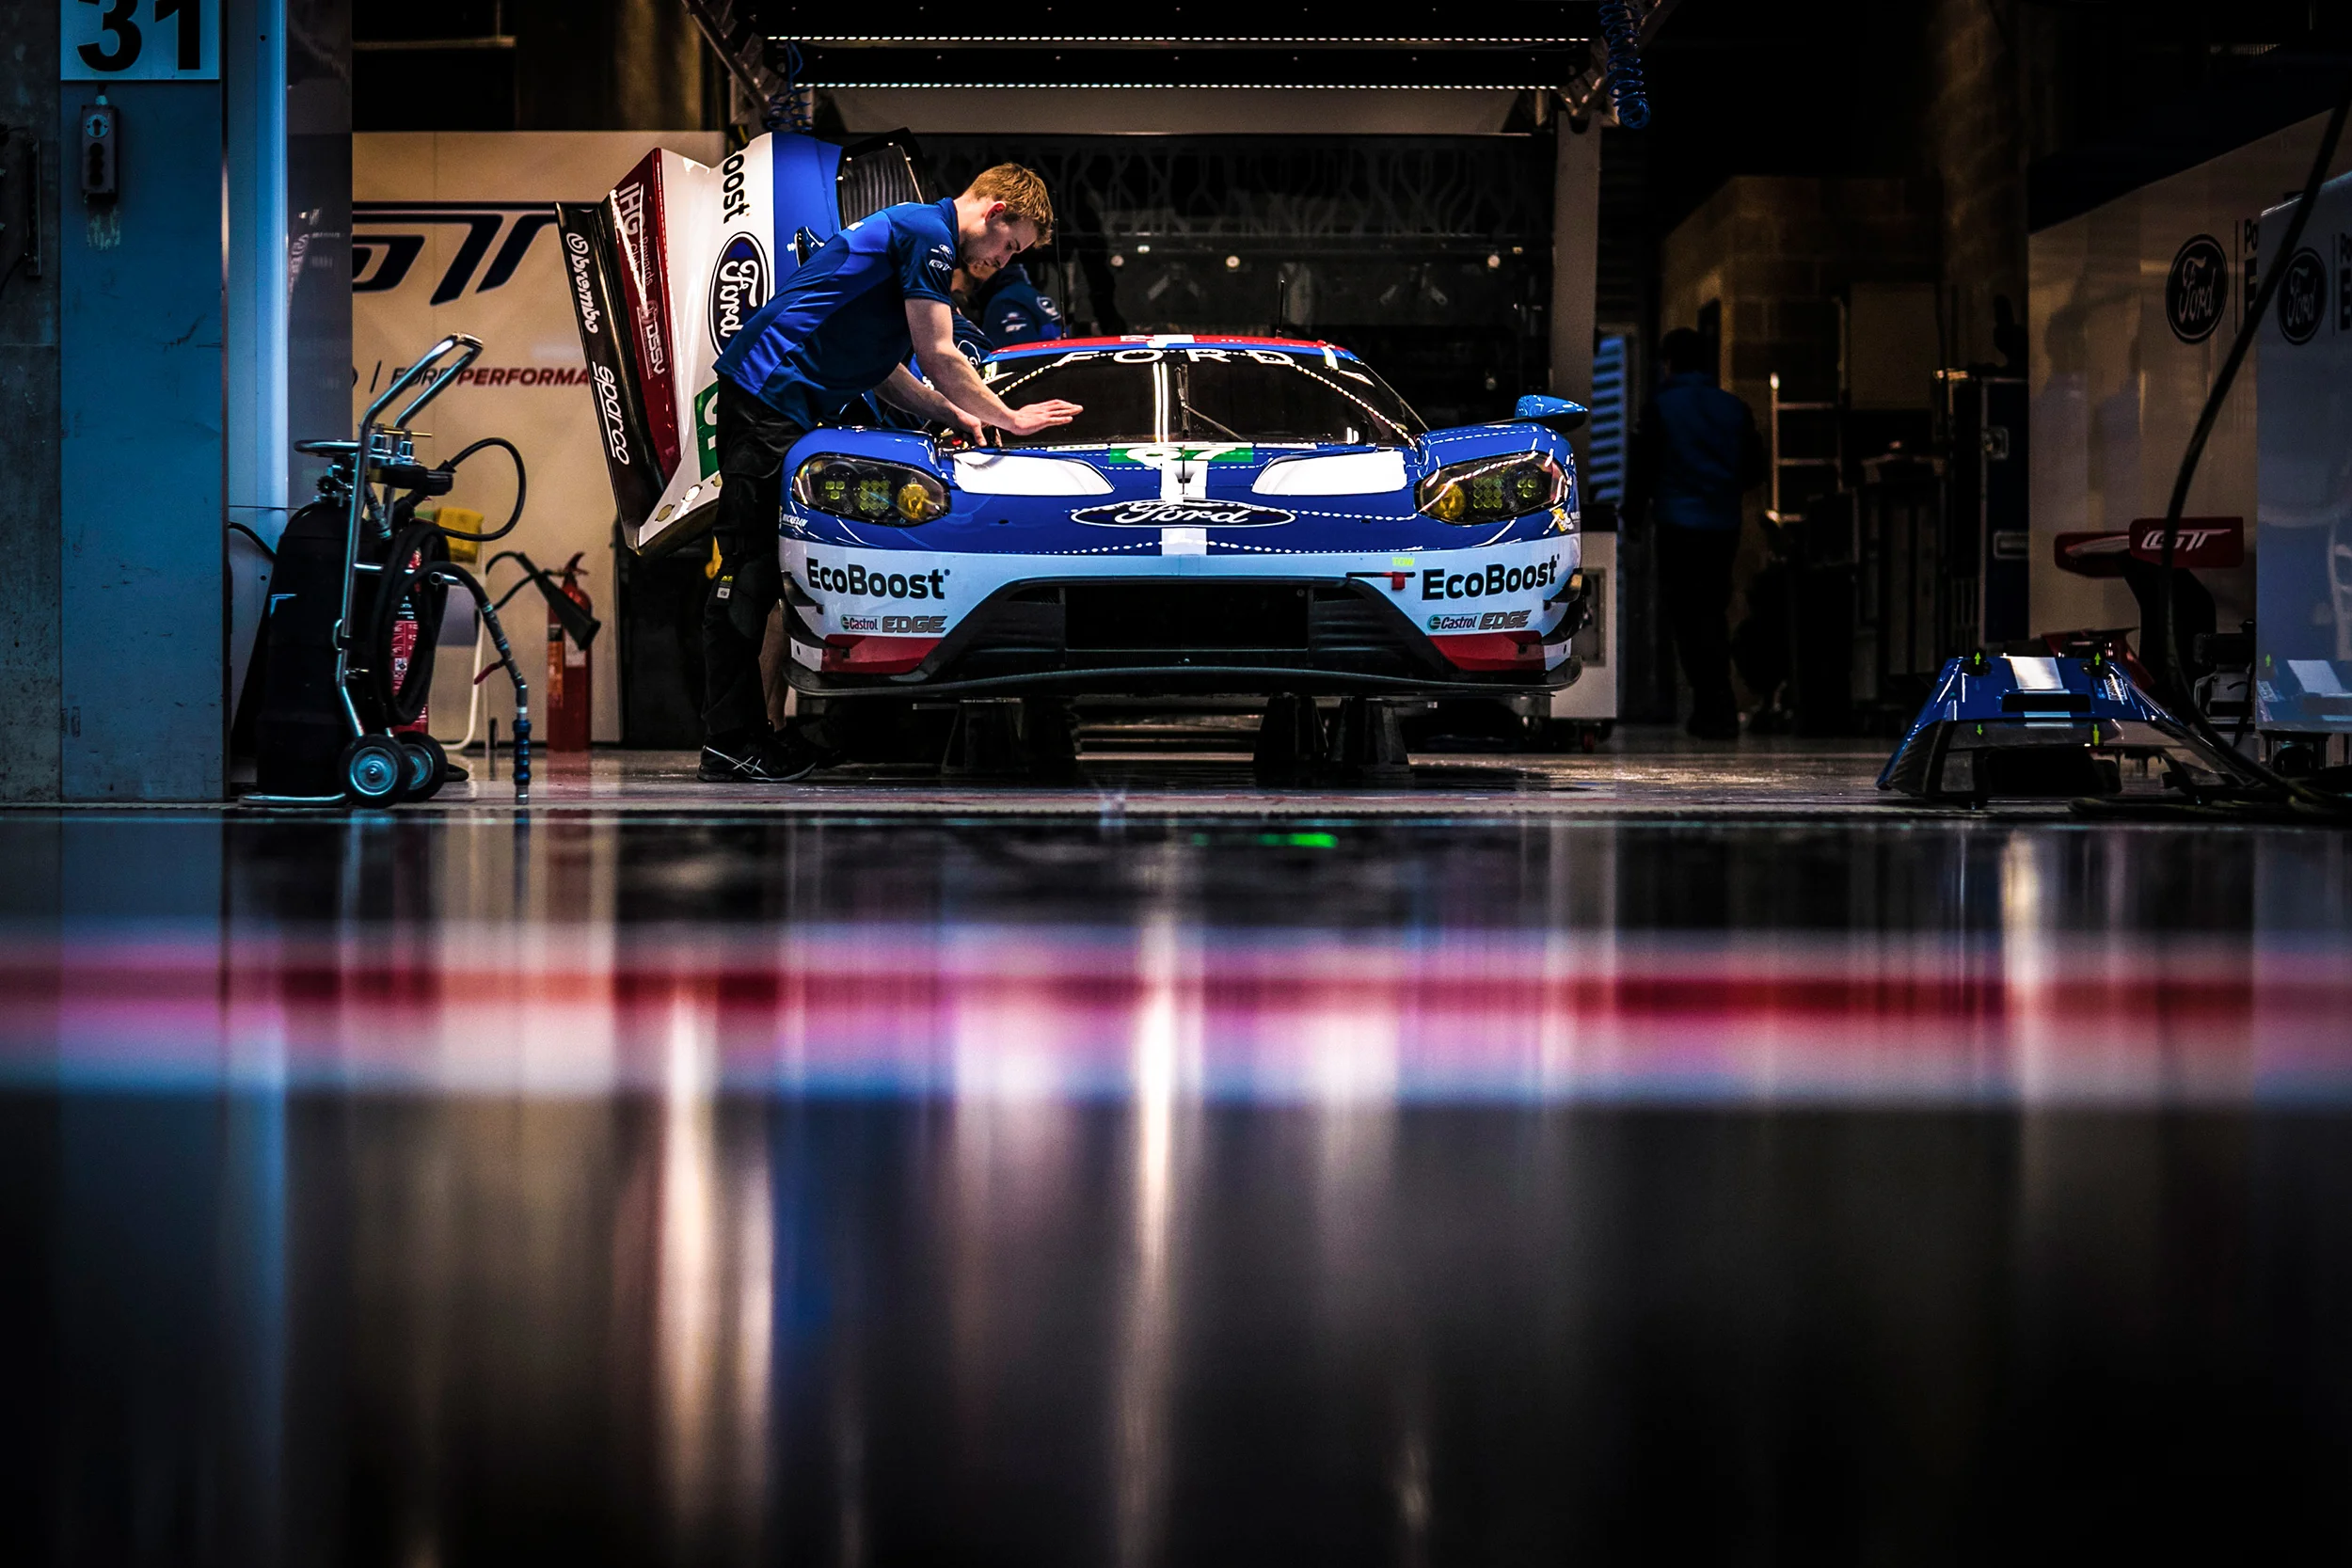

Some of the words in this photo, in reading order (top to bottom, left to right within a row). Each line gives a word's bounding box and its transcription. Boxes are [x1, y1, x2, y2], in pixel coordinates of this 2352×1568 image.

[77, 0, 201, 71] 31
[720, 260, 759, 338] Ford
[2178, 256, 2217, 325] Ford
[1052, 348, 1295, 368] FORD
[593, 361, 630, 466] sparco
[1114, 499, 1248, 524] Ford
[806, 557, 945, 600] EcoBoost
[1422, 555, 1557, 600] EcoBoost
[850, 617, 879, 630] Castrol
[882, 615, 948, 634] EDGE
[1440, 615, 1477, 630] Castrol
[1478, 610, 1532, 630] EDGE
